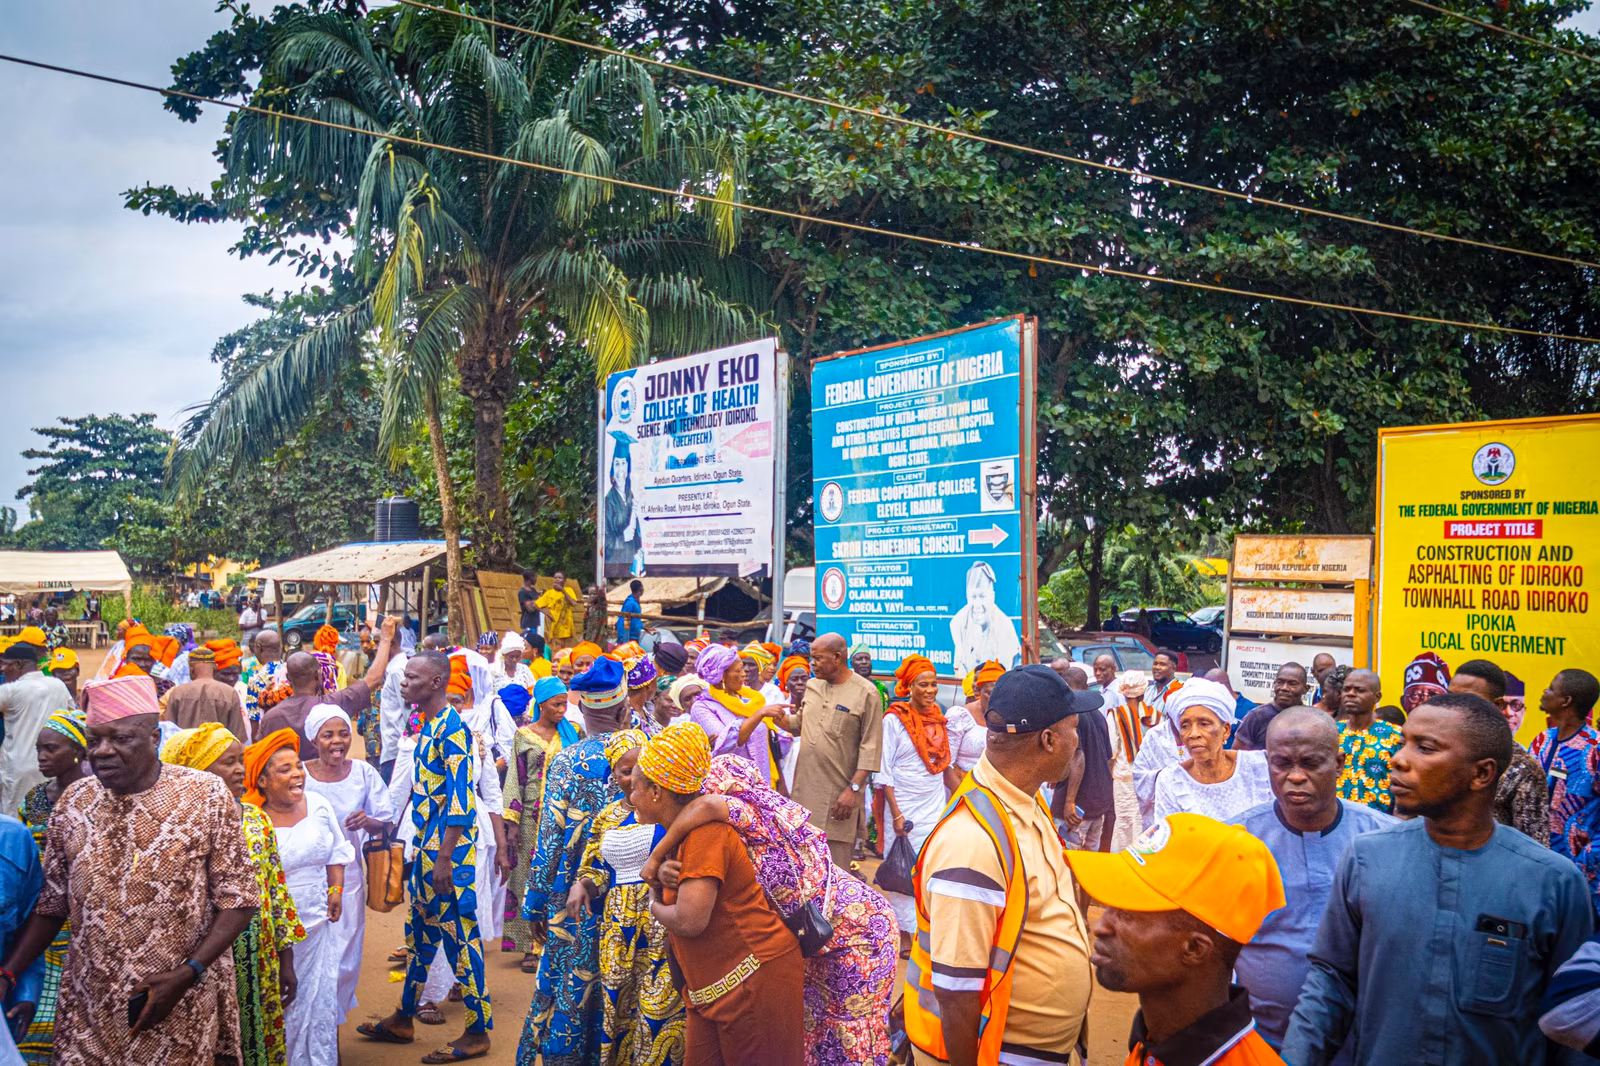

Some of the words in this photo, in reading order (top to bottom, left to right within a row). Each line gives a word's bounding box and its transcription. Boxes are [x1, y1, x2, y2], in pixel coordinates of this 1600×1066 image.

[880, 355, 925, 370] SPONSORED
[927, 353, 940, 362] BY:
[644, 363, 710, 401] JONNY
[718, 353, 760, 388] EKO
[825, 378, 865, 406] FEDERAL
[867, 365, 938, 399] GOVERNMENT
[940, 360, 954, 386] OF
[956, 350, 1004, 384] NIGERIA
[643, 396, 688, 423] COLLEGE
[692, 393, 707, 414] OF
[712, 384, 759, 412] HEALTH
[879, 400, 912, 411] PROJECT
[836, 416, 885, 434] CONSTRUCTION
[886, 414, 895, 426] OF
[948, 401, 970, 416] TOWN
[972, 397, 989, 413] HALL
[637, 422, 660, 439] SCIENCE
[663, 420, 677, 435] AND
[680, 412, 722, 434] TECHNOLOGY
[832, 435, 844, 448] AND
[846, 432, 865, 446] OTHER
[866, 427, 900, 443] FACILITIES
[902, 422, 926, 438] BEHIND
[928, 417, 958, 435] GENERAL
[958, 412, 994, 430] HOSPITAL
[704, 454, 716, 463] SITE
[888, 455, 907, 468] OGUN
[714, 470, 727, 482] Ogun
[896, 472, 923, 482] CLIENT
[678, 493, 707, 501] PRESENTLY
[848, 488, 881, 504] FEDERAL
[881, 482, 937, 501] COOPERATIVE
[938, 478, 978, 497] COLLEGE,
[1460, 490, 1511, 500] SPONSORED
[1514, 489, 1526, 499] BY
[876, 502, 909, 518] ELEYELE,
[1399, 505, 1415, 518] THE
[1418, 504, 1458, 517] FEDERAL
[1462, 502, 1533, 516] GOVERNMENT
[1536, 502, 1550, 515] OF
[1552, 501, 1599, 515] NIGERIA
[867, 526, 900, 535] PROJECT
[1450, 523, 1500, 536] PROJECT
[1504, 523, 1535, 536] TITLE
[863, 537, 920, 557] ENGINEERING
[922, 534, 965, 554] CONSULT
[1416, 545, 1532, 561] CONSTRUCTION
[1538, 545, 1574, 562] AND
[848, 577, 868, 588] SEN.
[870, 576, 913, 587] SOLOMON
[1408, 564, 1492, 585] ASPHALTING
[1499, 564, 1516, 586] OF
[1521, 565, 1583, 587] IDIROKO
[38, 580, 72, 589] RENTALS
[848, 590, 904, 600] OLAMILEKAN
[1403, 588, 1476, 609] TOWNHALL
[1482, 590, 1520, 611] ROAD
[1527, 590, 1588, 614] IDIROKO
[849, 602, 883, 613] ADEOLA
[884, 602, 904, 612] YAYI
[1467, 614, 1516, 632] IPOKIA
[878, 634, 913, 647] PRODUCTS
[914, 635, 926, 648] LTD
[1421, 631, 1465, 650] LOCAL
[1471, 633, 1566, 656] GOVERMENT
[1240, 661, 1270, 670] REHABILITATION
[1242, 670, 1264, 679] COMMUNITY
[1244, 680, 1266, 688] TRANSPORT
